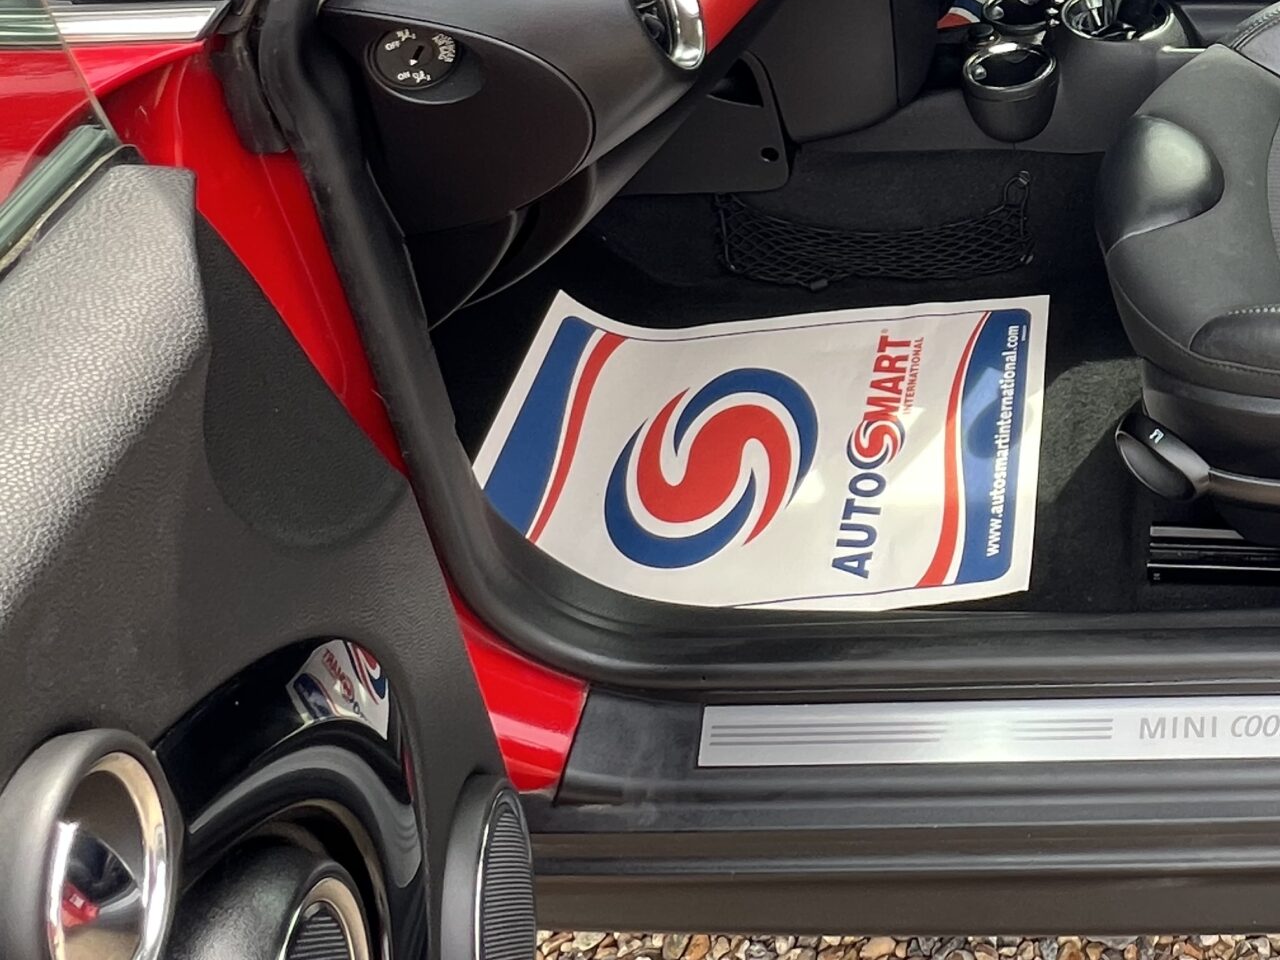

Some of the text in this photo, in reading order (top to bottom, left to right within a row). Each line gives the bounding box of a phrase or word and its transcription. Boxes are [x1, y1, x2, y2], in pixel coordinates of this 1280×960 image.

[384, 40, 401, 51] OFF
[397, 71, 411, 81] ON
[903, 337, 924, 415] INTERNATIONAL
[986, 325, 1020, 557] www.autosmartinternational.com
[1139, 716, 1218, 740] MINI
